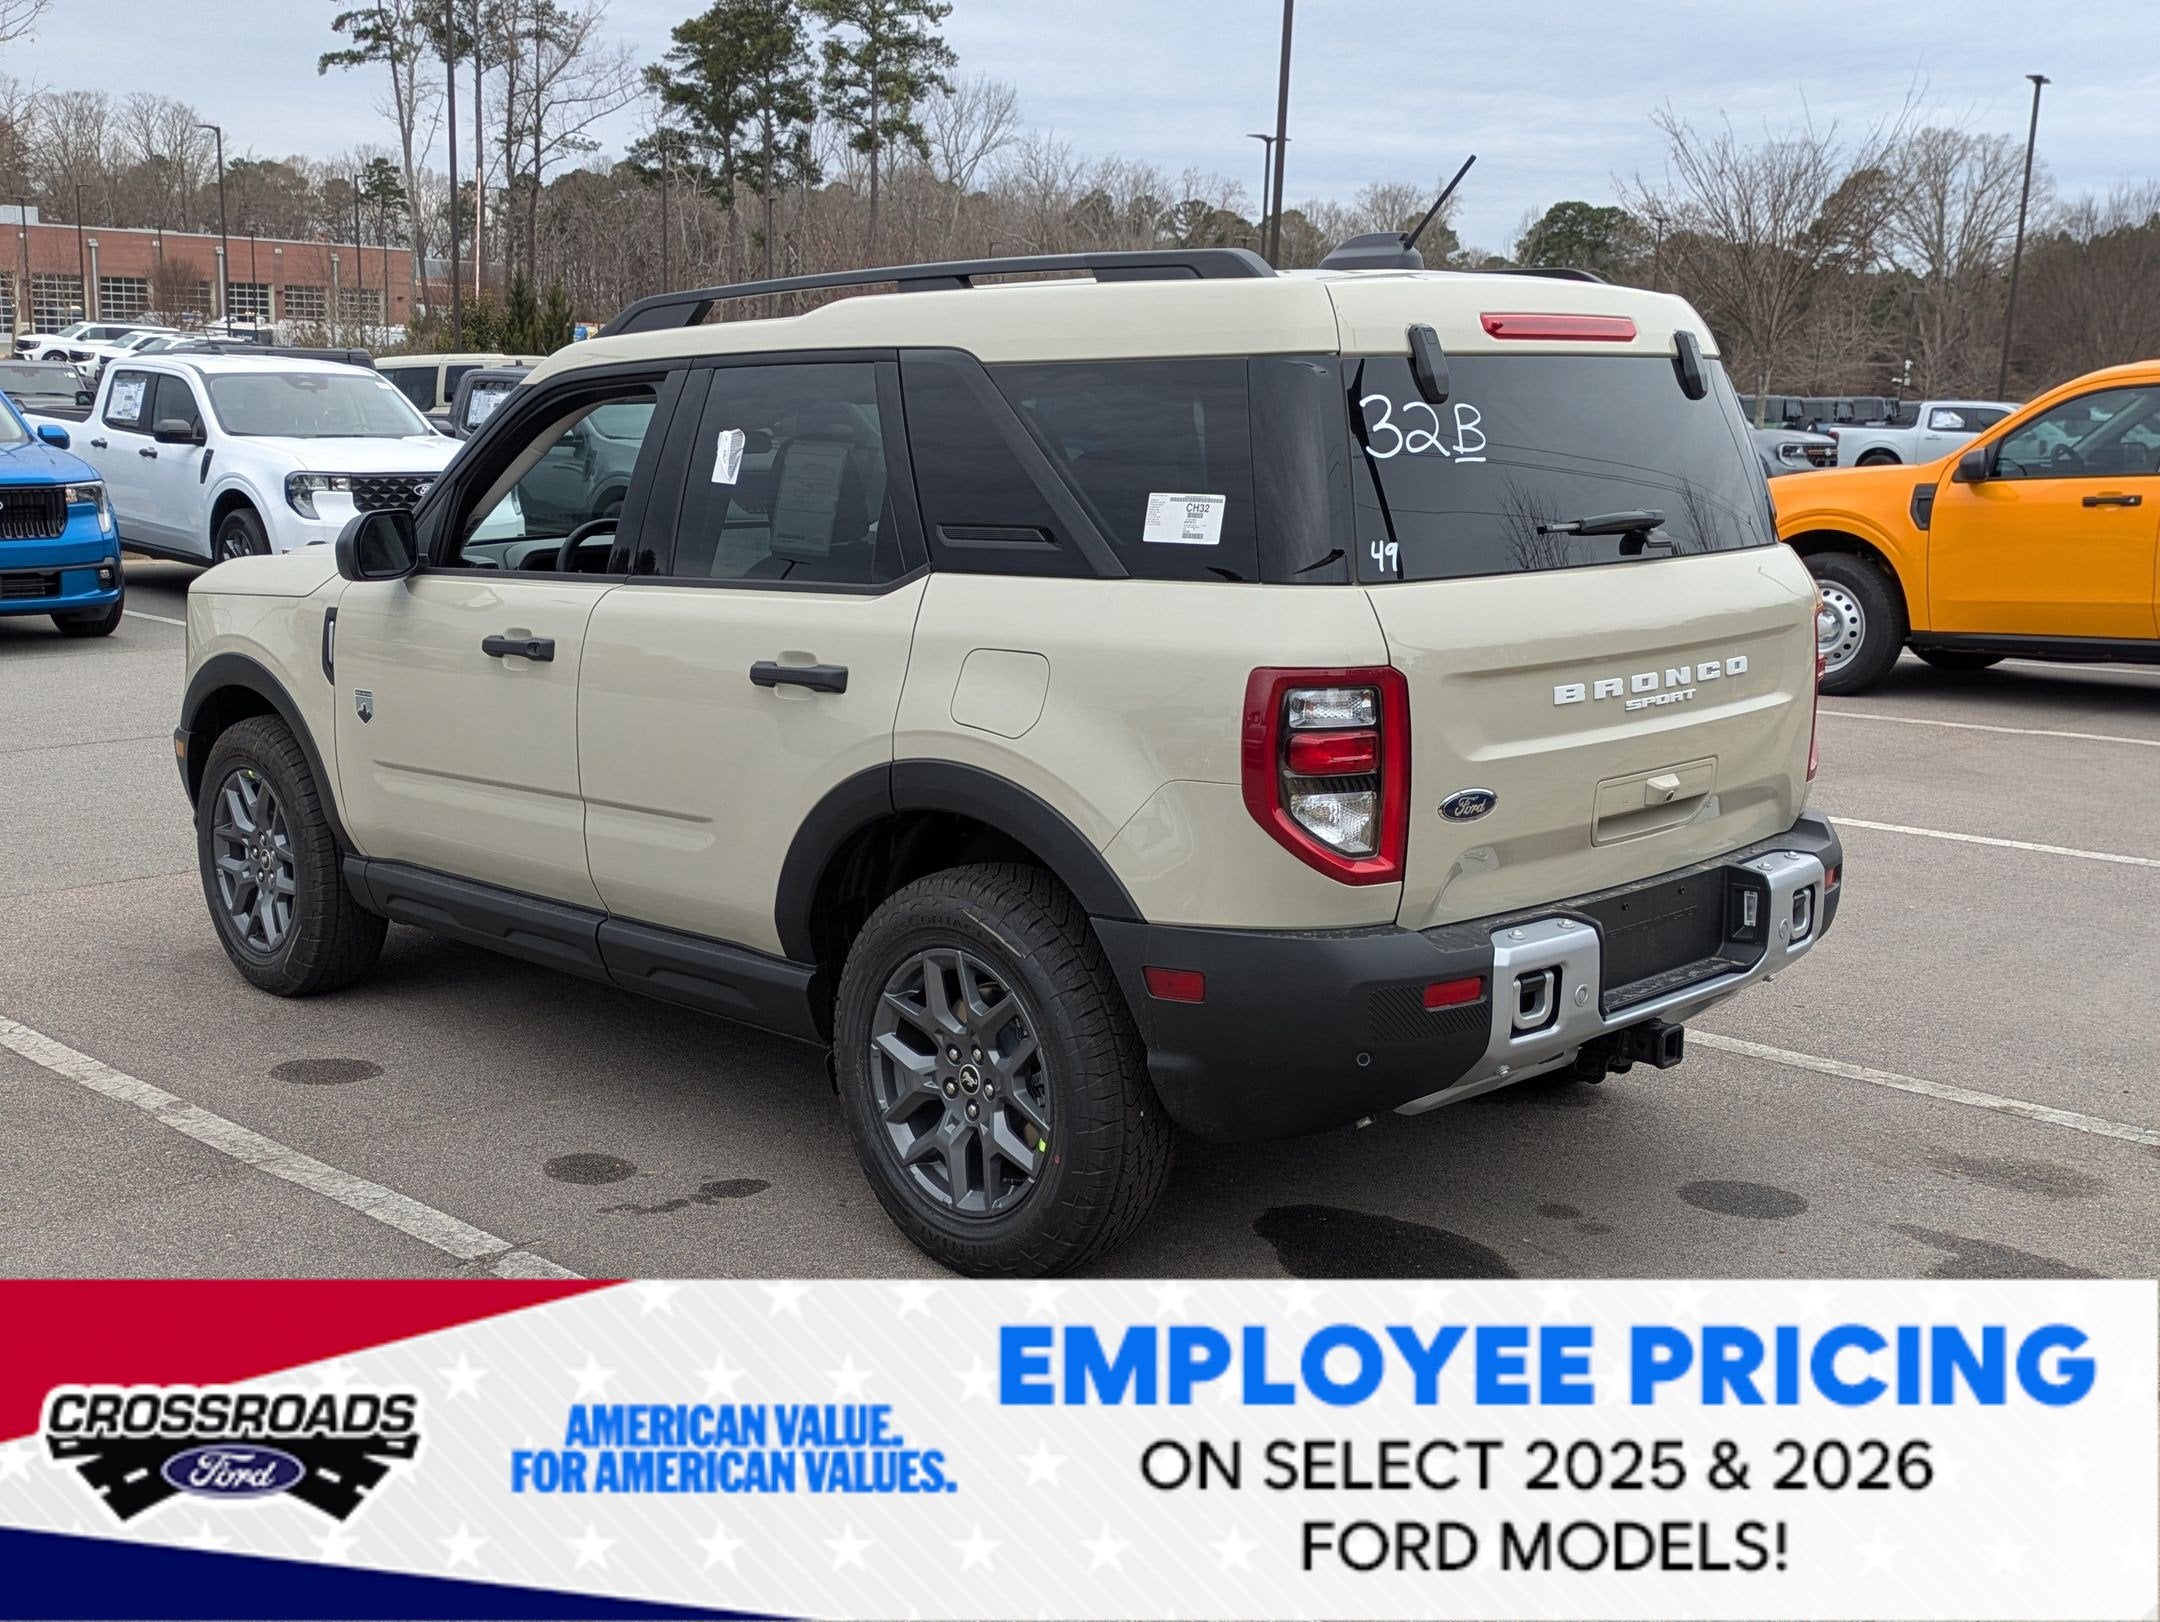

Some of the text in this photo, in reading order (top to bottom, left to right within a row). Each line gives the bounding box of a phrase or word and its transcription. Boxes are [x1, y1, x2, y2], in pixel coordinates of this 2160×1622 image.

[1186, 503, 1210, 513] CH32
[1371, 540, 1399, 572] 49
[1553, 655, 1748, 706] BRONCO
[1624, 688, 1696, 711] SPORT
